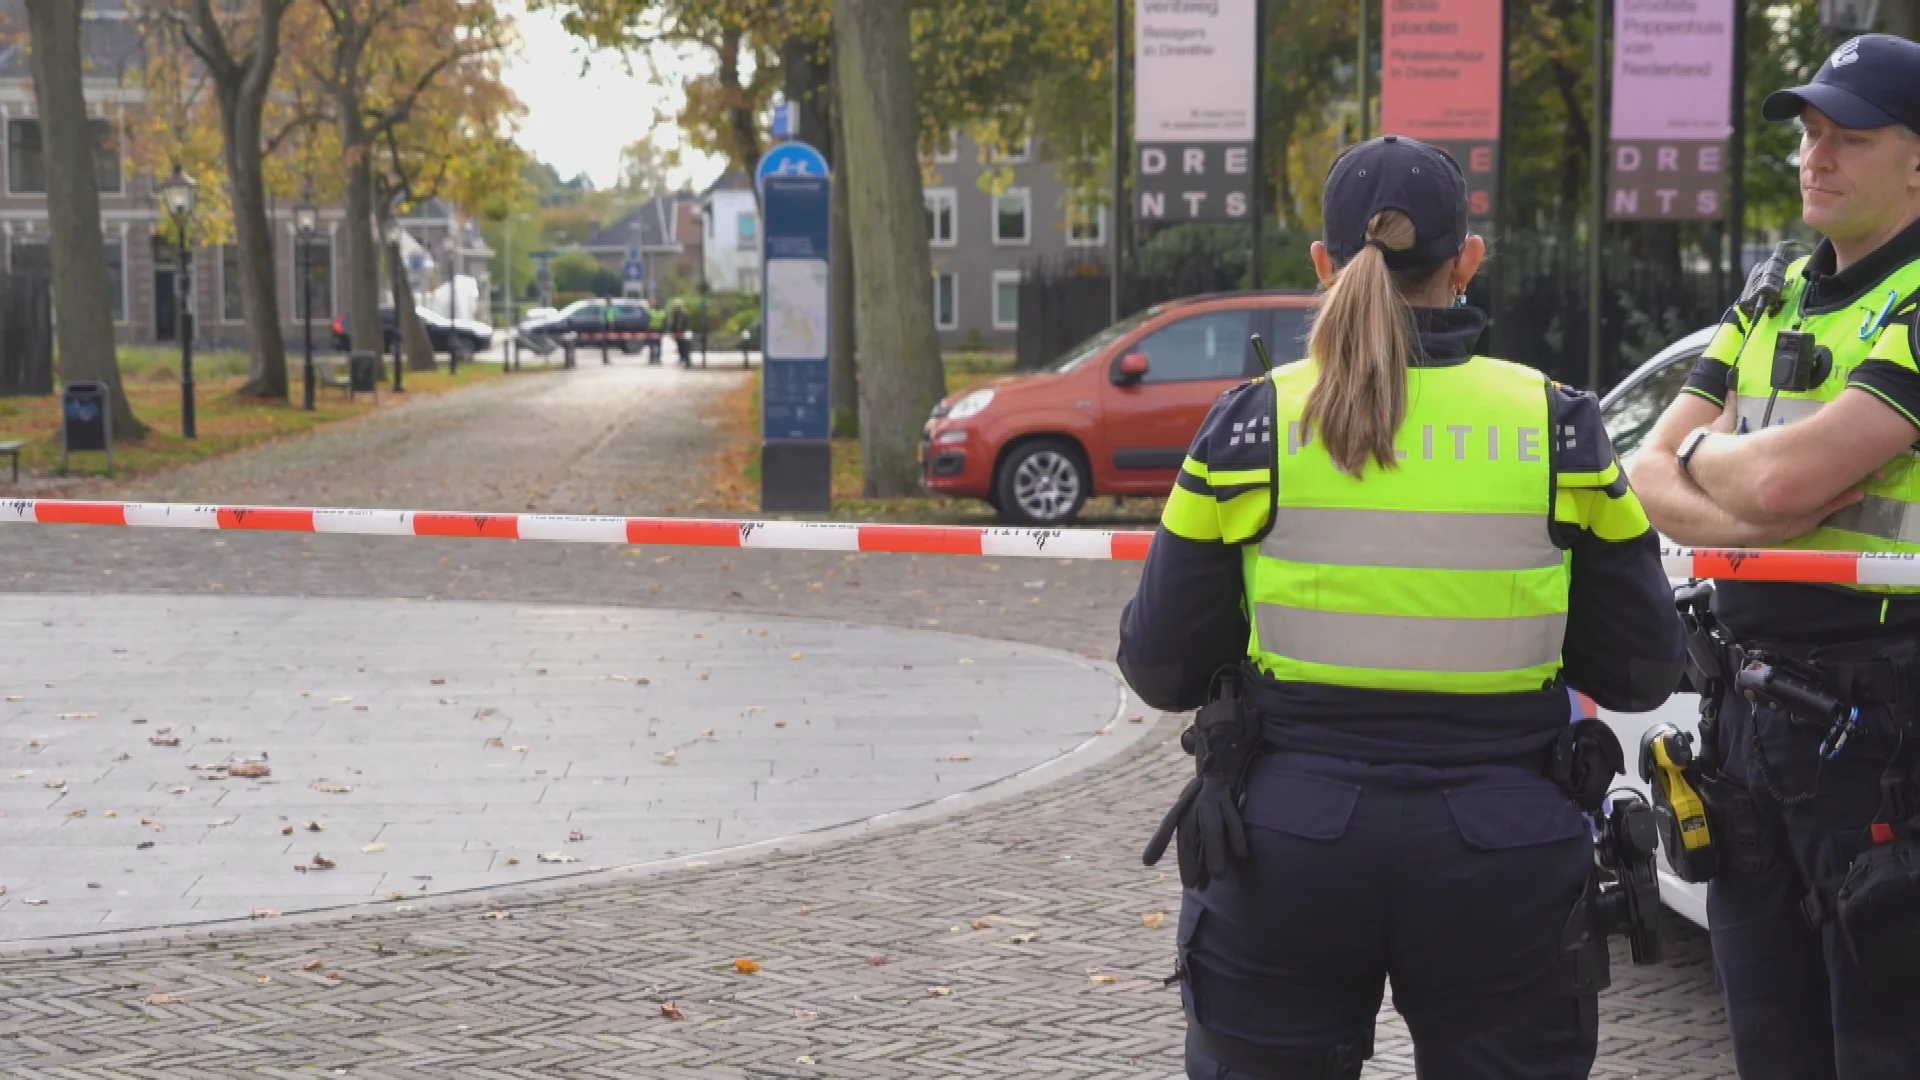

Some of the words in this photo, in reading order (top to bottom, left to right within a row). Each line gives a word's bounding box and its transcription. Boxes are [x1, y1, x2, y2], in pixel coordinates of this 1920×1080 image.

[1623, 17, 1724, 37] Poppenhuis
[1159, 44, 1215, 57] Drenthe
[1623, 43, 1654, 54] van
[1622, 61, 1712, 77] Nederland
[1288, 421, 1540, 462] PITIE
